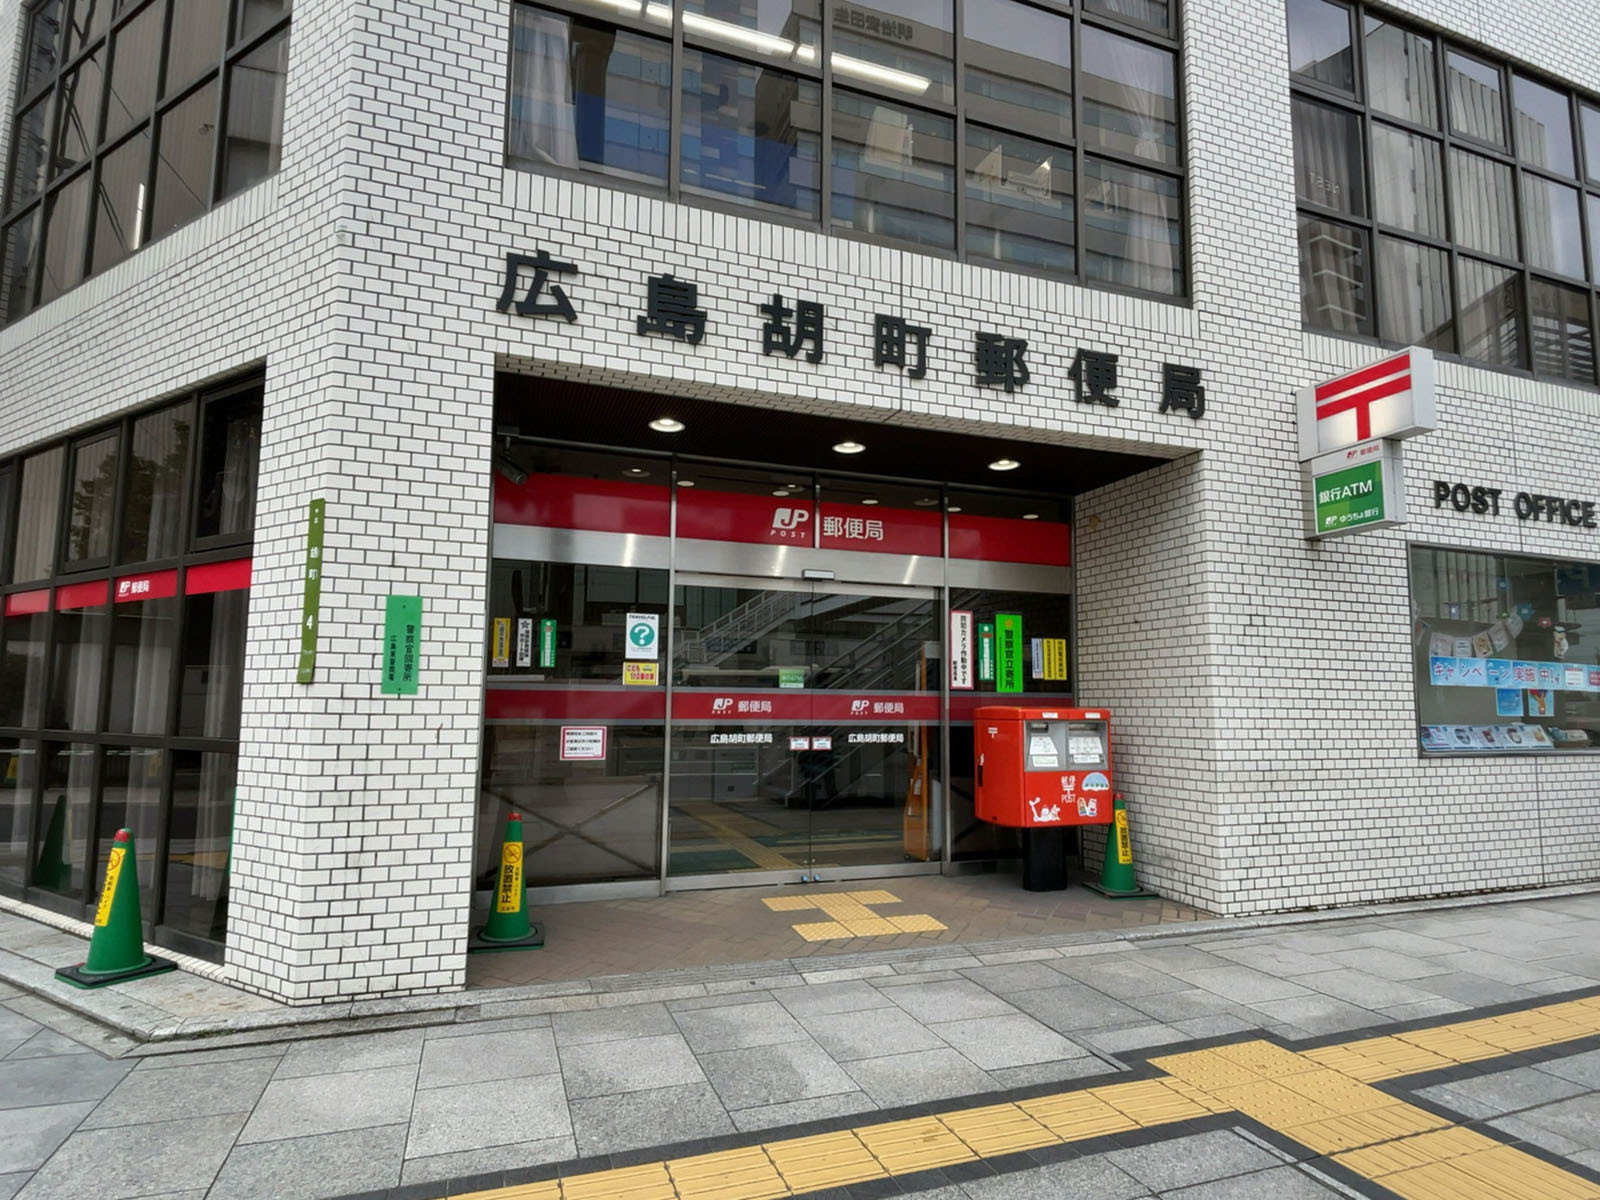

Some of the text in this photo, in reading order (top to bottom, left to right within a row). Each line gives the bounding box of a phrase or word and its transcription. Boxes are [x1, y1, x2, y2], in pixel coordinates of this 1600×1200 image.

[496, 250, 1205, 419] 広島胡町郵便局
[1319, 479, 1373, 505] 銀行ATM
[1434, 480, 1598, 529] POST OFFICE
[772, 507, 809, 530] JP
[1339, 507, 1379, 523] ゆうちょ銀行
[770, 530, 807, 539] POST
[823, 516, 884, 541] 郵便局
[305, 614, 313, 630] 4
[712, 697, 772, 713] JP 郵便局
[851, 699, 904, 714] JP 郵便局
[710, 733, 773, 745] 広島胡町郵便局
[847, 732, 905, 744] 広島胡町郵便局
[1061, 794, 1076, 803] POST
[501, 864, 514, 903] 放置禁止
